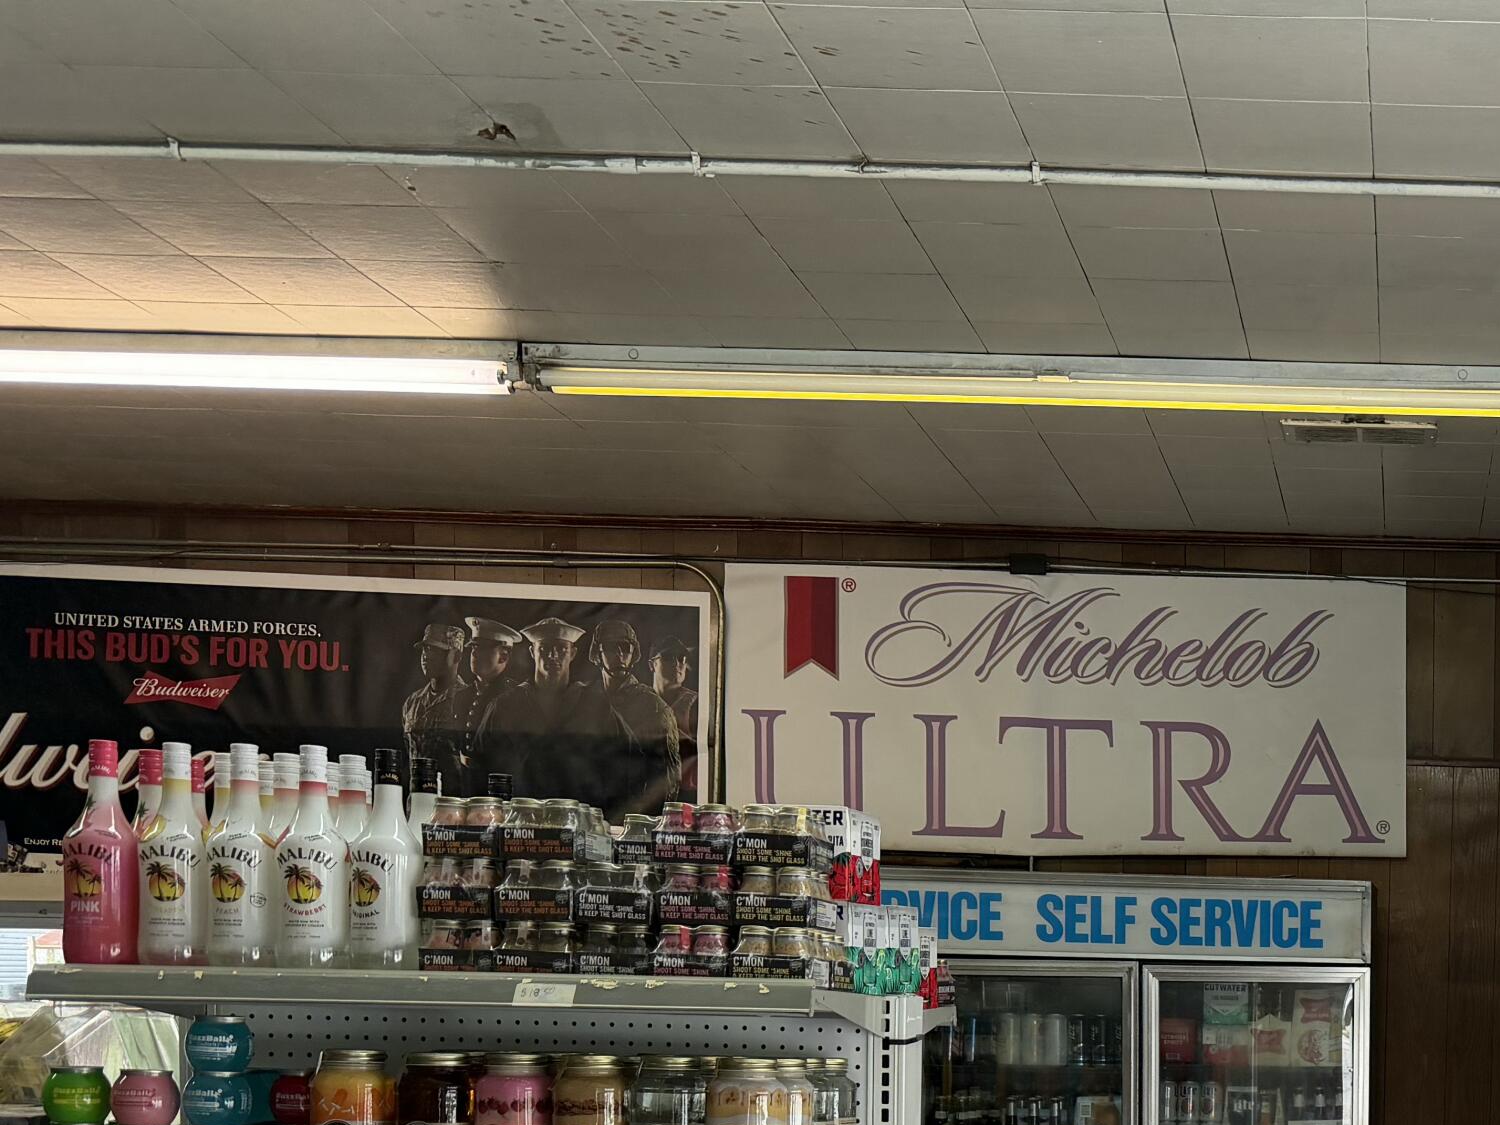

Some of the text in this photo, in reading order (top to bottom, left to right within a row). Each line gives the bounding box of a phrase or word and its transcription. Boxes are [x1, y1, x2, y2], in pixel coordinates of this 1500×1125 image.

[54, 612, 322, 638] UNITED STATES ARMED FORCES,
[864, 581, 1335, 689] Michelob
[26, 627, 350, 672] THIS BUD'S FOR YOU.
[133, 677, 231, 700] Budweiser
[741, 708, 1385, 844] ULTRA
[62, 841, 116, 867] MALIBU
[737, 837, 768, 849] C'MON
[141, 843, 201, 870] MALIBU
[277, 847, 338, 873] MALIBU
[70, 901, 101, 914] PINK
[282, 902, 328, 917] STRAWBERRY
[579, 893, 609, 904] C'MON
[881, 889, 1004, 942] VICE
[1036, 893, 1139, 945] SELF
[1150, 895, 1325, 950] SERVICE
